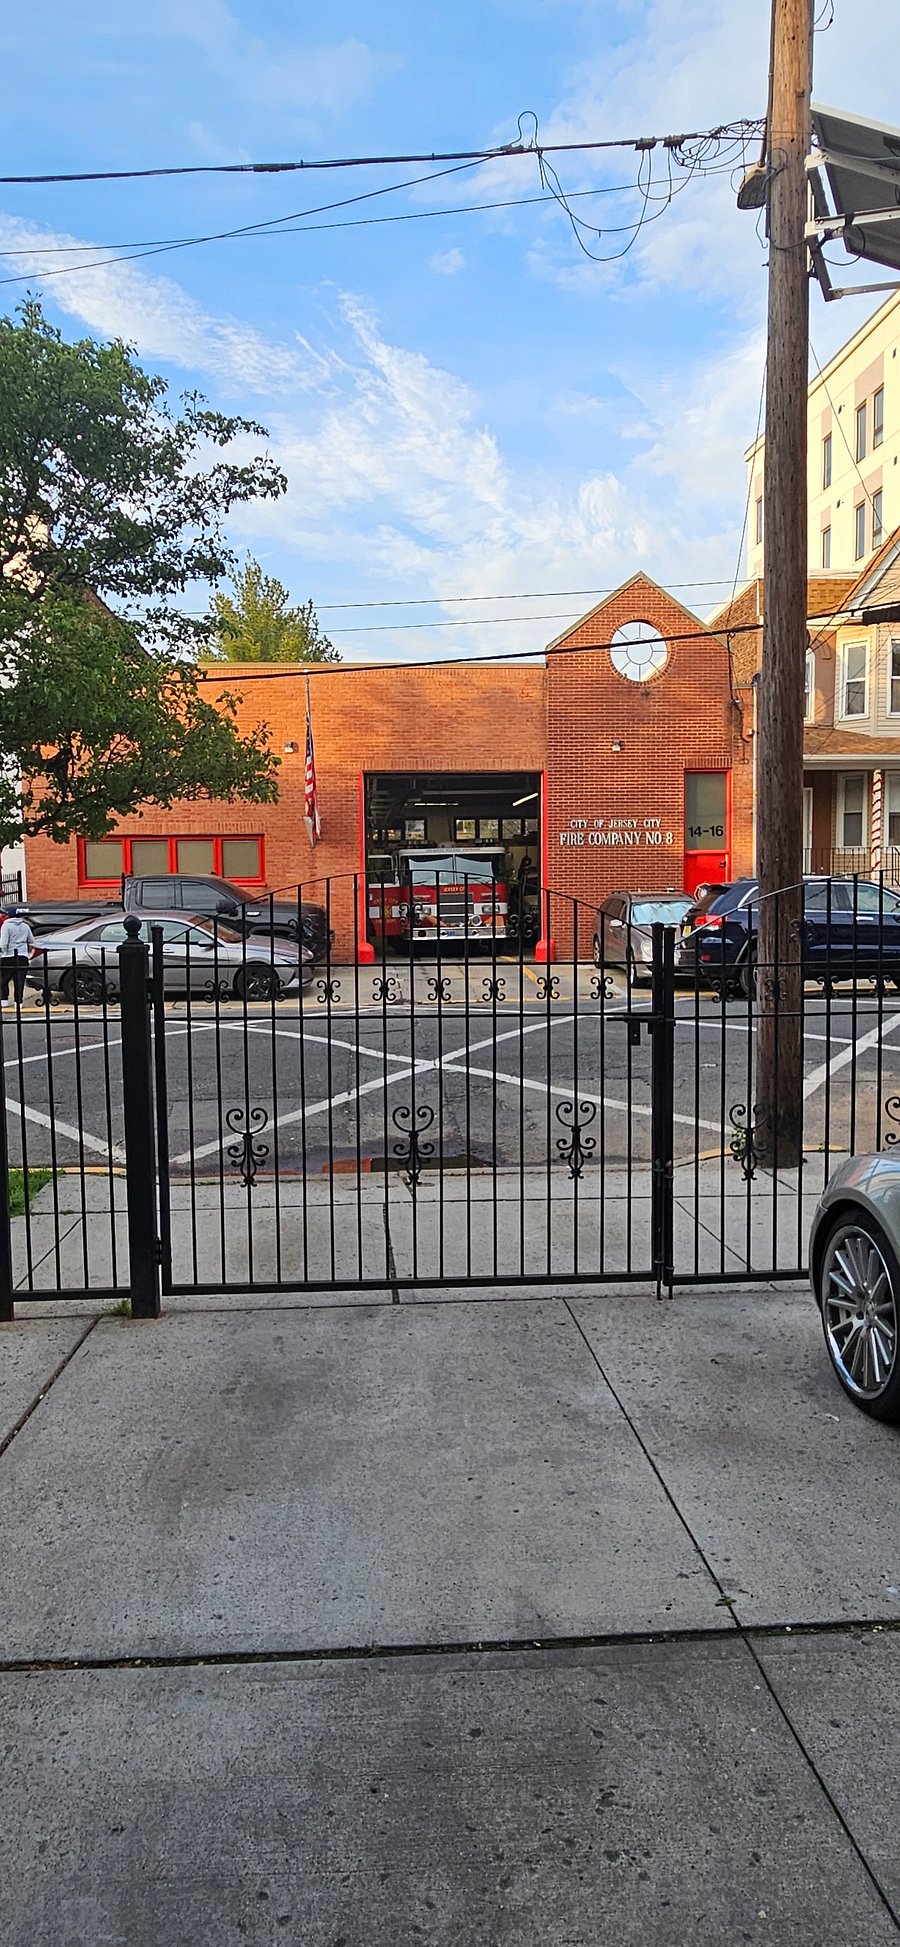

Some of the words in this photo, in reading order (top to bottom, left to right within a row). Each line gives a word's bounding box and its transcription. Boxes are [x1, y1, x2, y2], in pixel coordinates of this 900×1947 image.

[570, 819, 588, 829] CITY
[594, 819, 604, 828] OF
[609, 819, 638, 828] JERSEY
[644, 818, 661, 828] CITY
[687, 825, 724, 837] 14-16
[560, 833, 584, 846] FIRE
[588, 832, 642, 846] COMPANY
